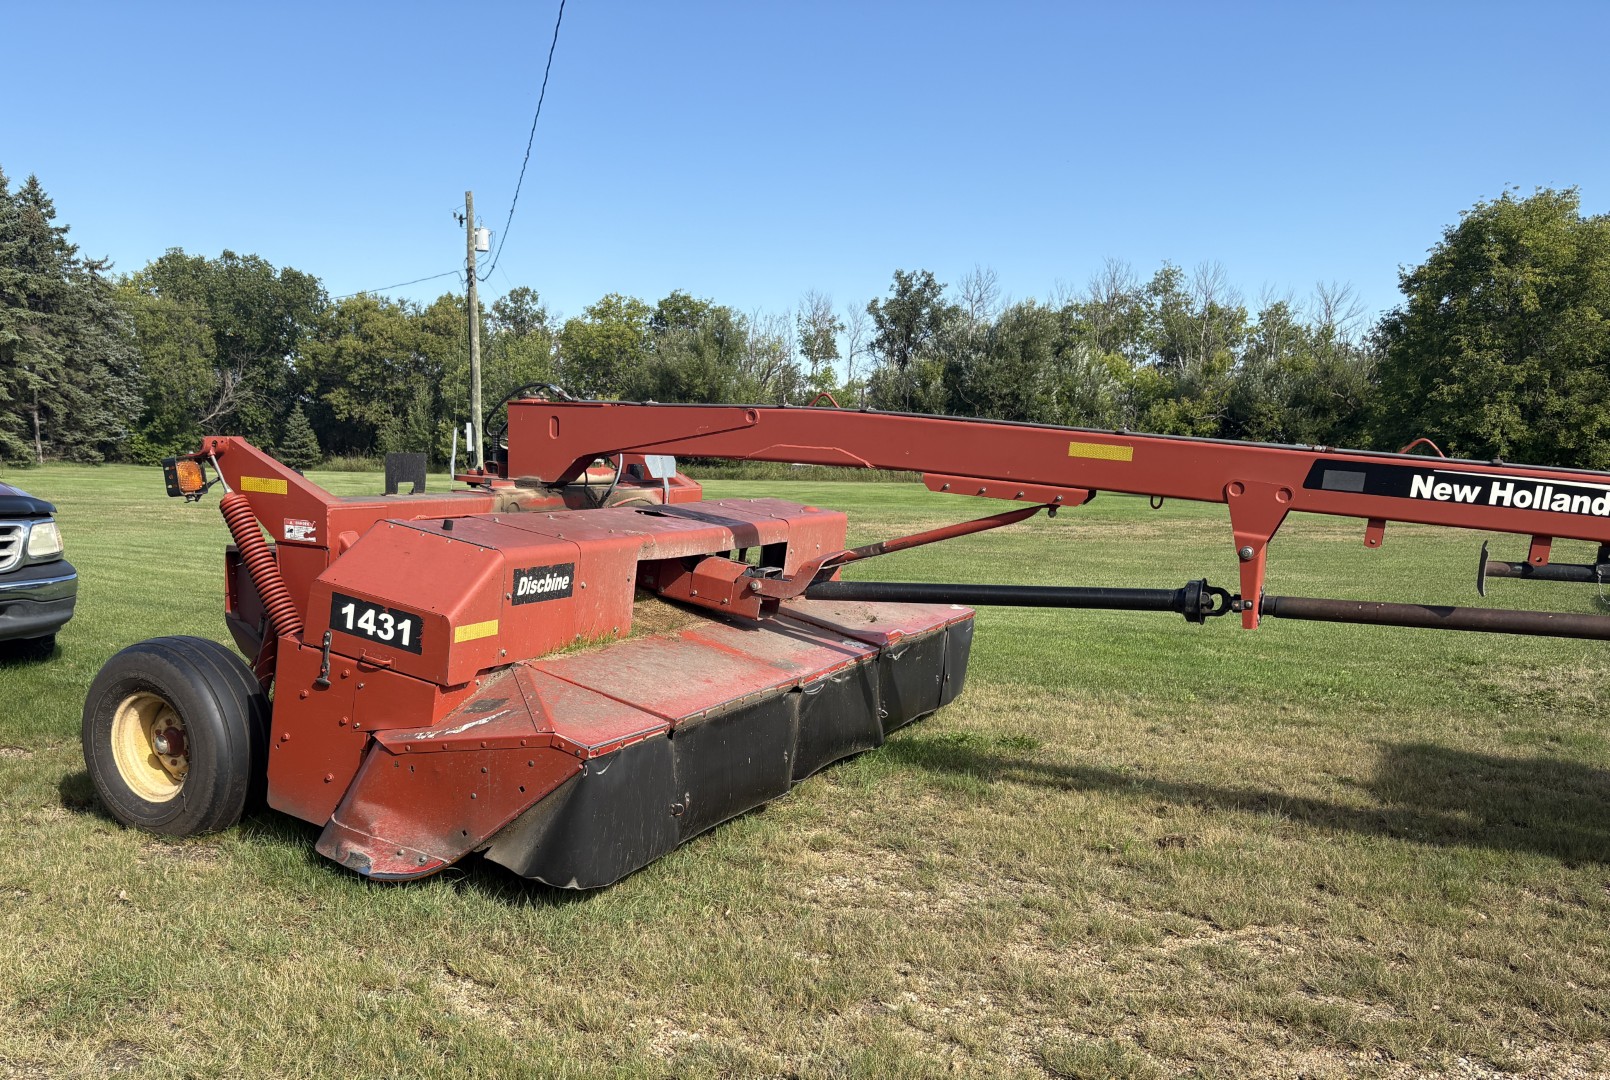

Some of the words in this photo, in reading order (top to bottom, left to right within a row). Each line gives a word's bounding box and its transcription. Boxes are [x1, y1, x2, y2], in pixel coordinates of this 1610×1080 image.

[1409, 475, 1482, 503] New
[1488, 481, 1610, 516] Holland
[516, 574, 570, 596] Discbine
[341, 603, 412, 646] 1431
